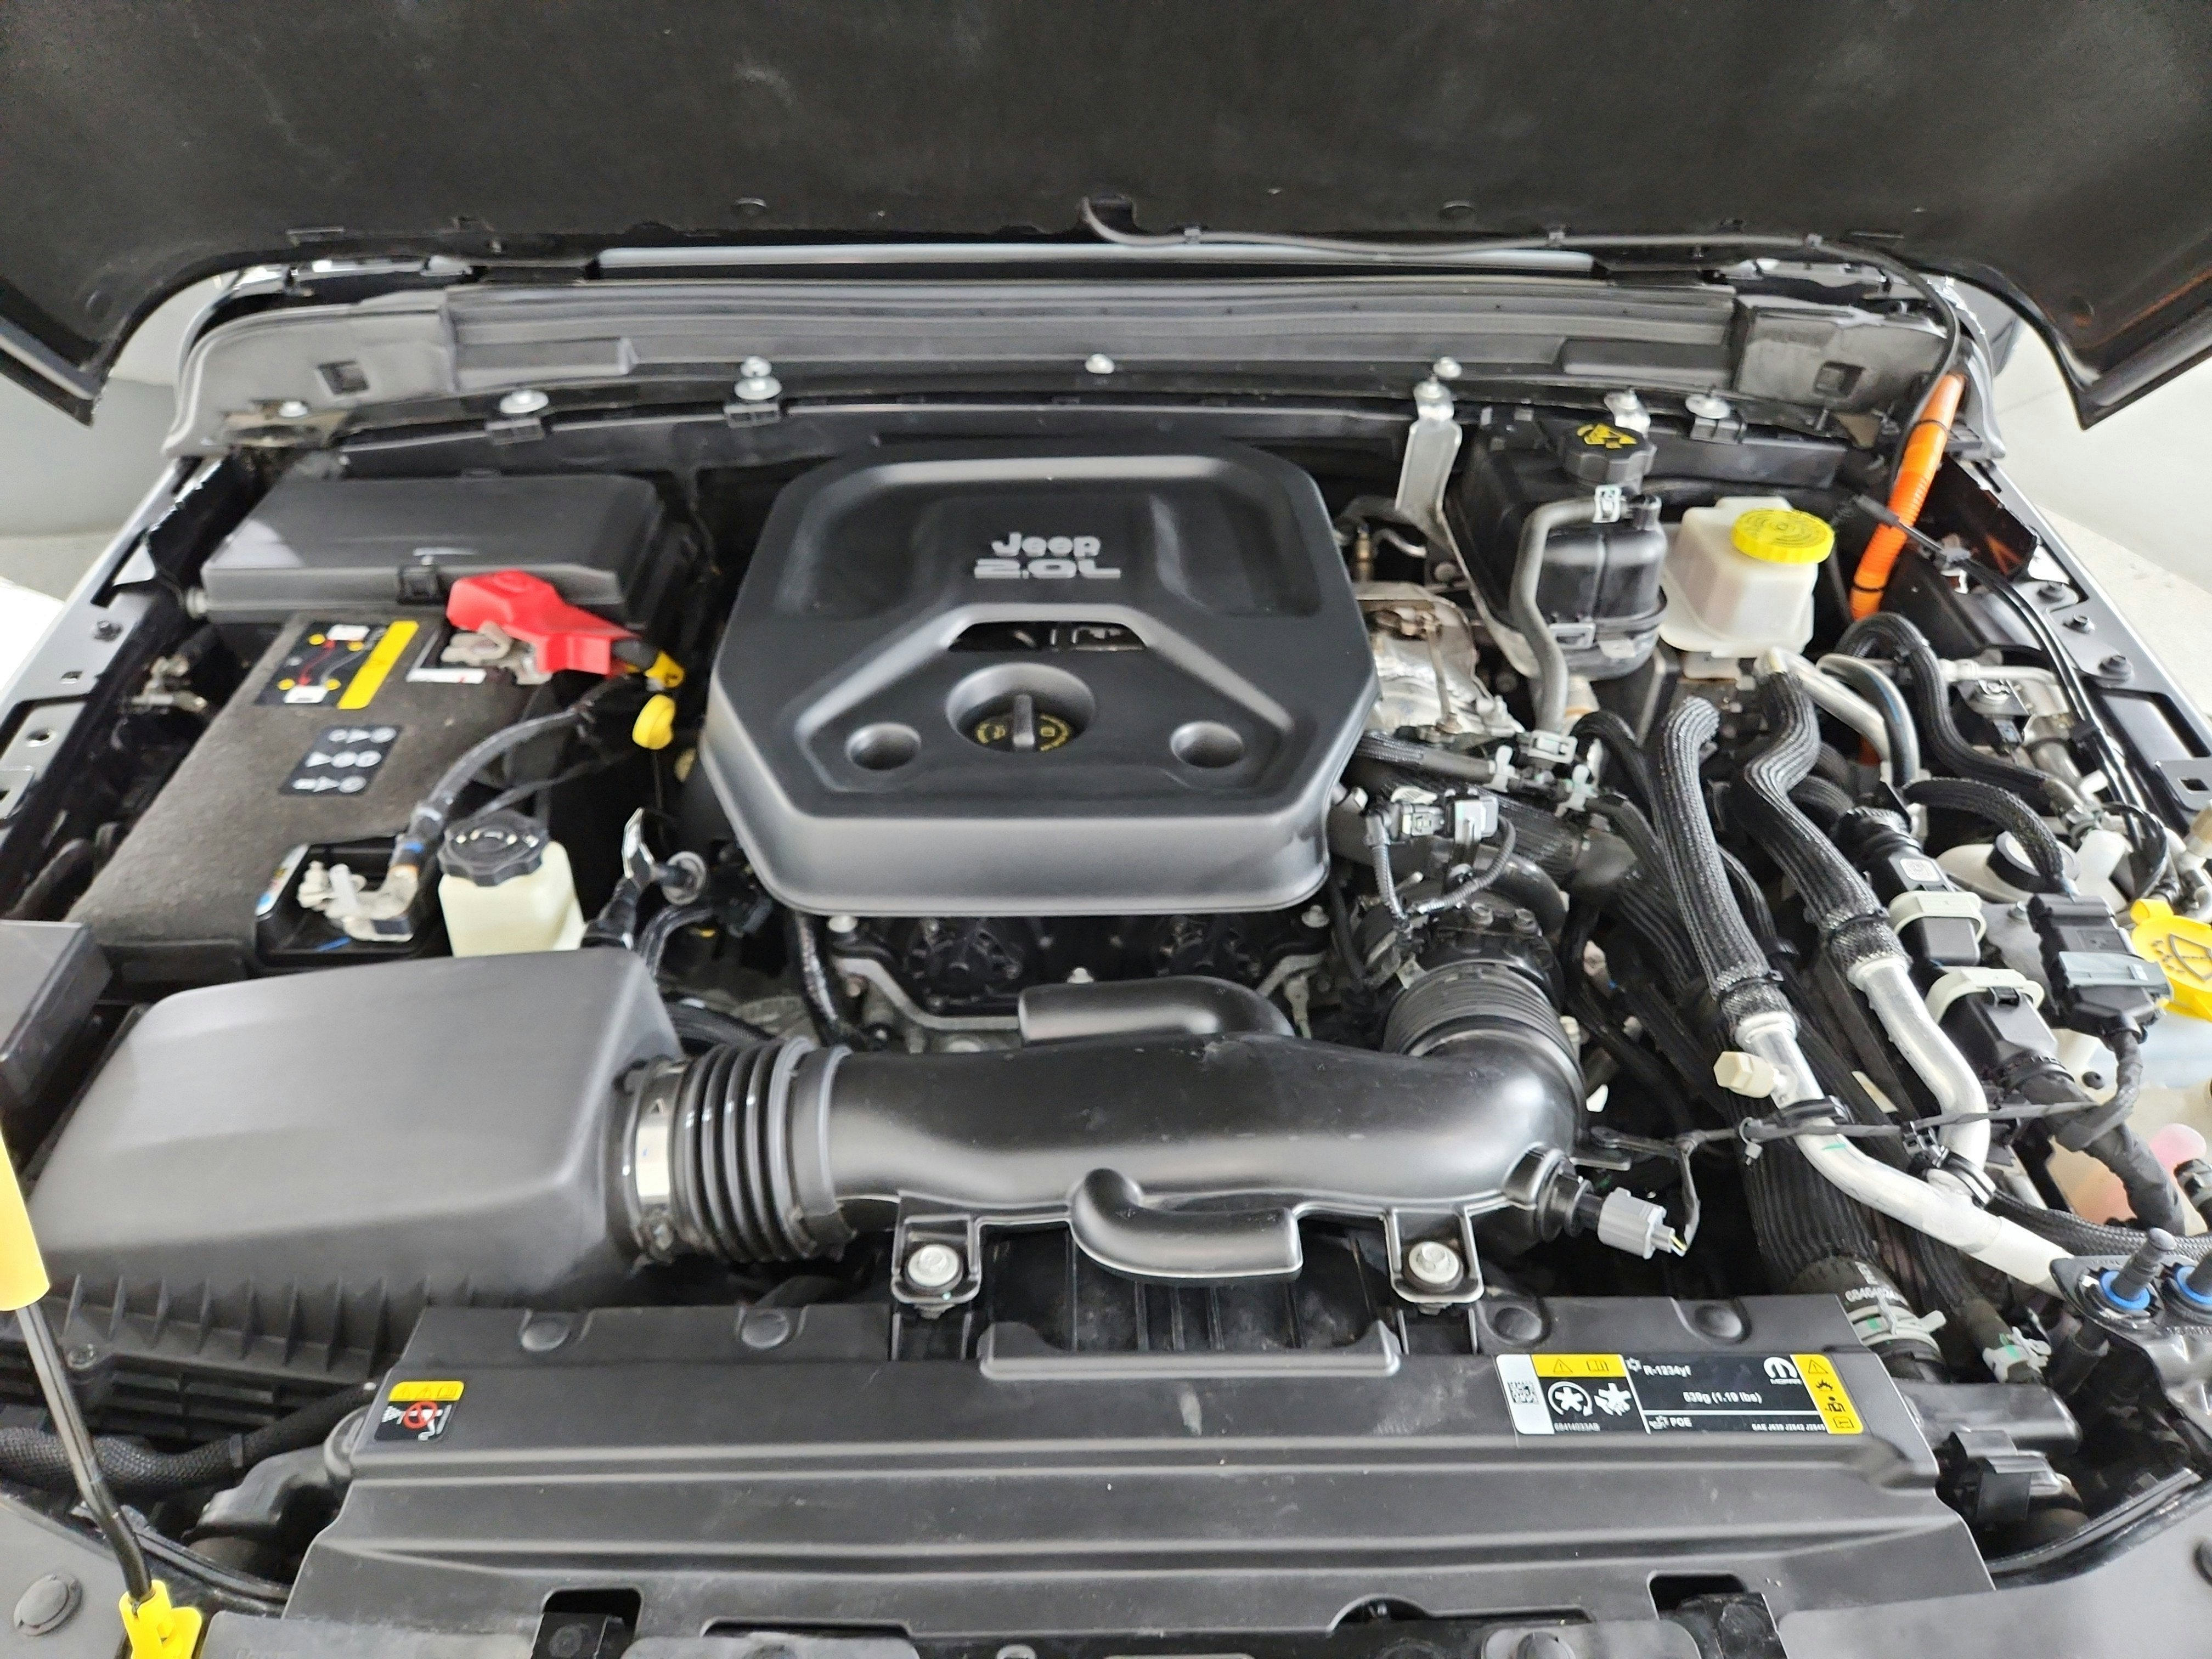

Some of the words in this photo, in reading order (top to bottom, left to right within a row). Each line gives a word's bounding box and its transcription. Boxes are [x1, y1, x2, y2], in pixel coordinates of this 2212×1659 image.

[992, 532, 1101, 557] Jeep
[974, 558, 1121, 579] 2.0L
[1739, 1391, 1762, 1404] lbs)
[1669, 1417, 1692, 1427] POE
